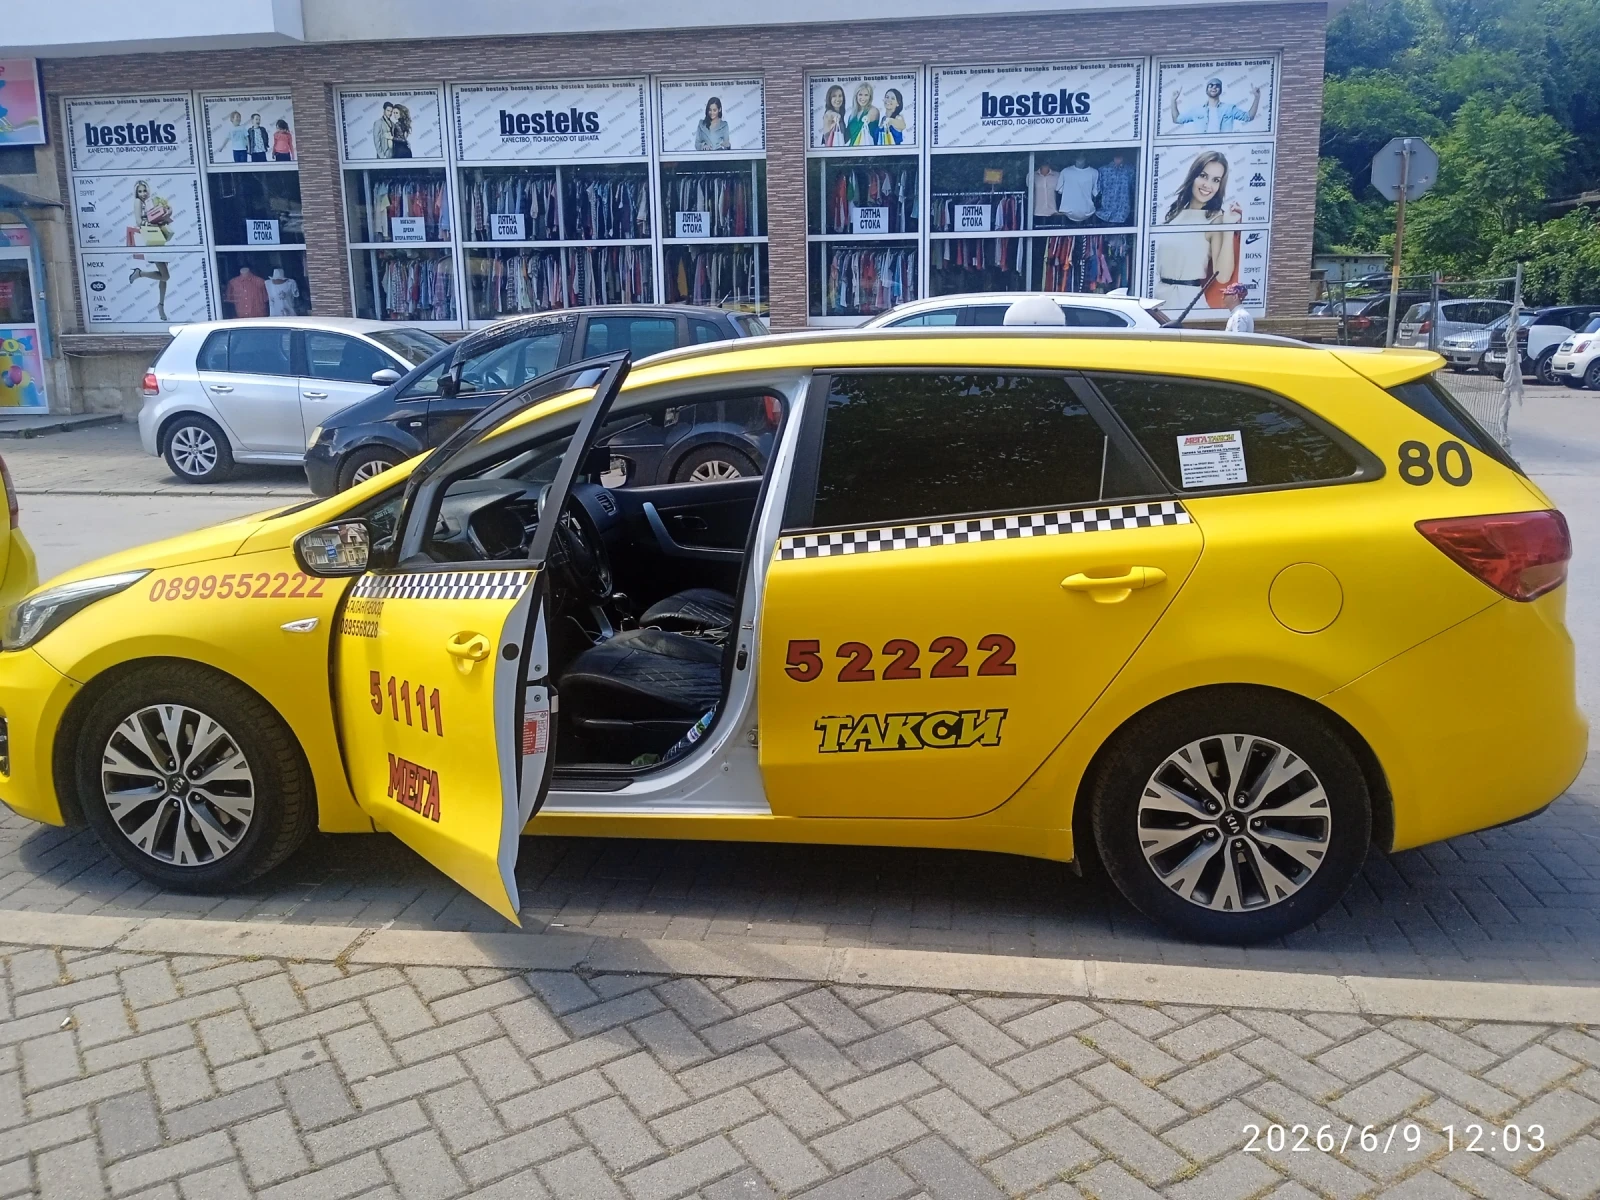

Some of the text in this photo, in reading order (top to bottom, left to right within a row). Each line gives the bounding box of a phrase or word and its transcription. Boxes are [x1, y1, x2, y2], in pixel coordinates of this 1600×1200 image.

[982, 89, 1090, 117] besteks
[499, 108, 599, 135] besteks
[84, 120, 176, 146] besteks
[860, 209, 881, 219] ЛЯТНА
[962, 207, 983, 217] ЛЯТНА
[498, 216, 518, 225] ЛЯТНА
[683, 213, 702, 223] ЛЯТНА
[962, 218, 983, 227] СТОКА
[254, 222, 272, 231] ЛЯТНА
[683, 224, 703, 233] СТОКА
[860, 220, 881, 229] СТОКА
[499, 226, 518, 235] СТОКА
[254, 232, 273, 241] СТОКА
[1398, 440, 1472, 487] 80
[149, 572, 326, 602] 0899552222
[814, 708, 1008, 753] ТАКСИ
[388, 752, 440, 823] МЕГА
